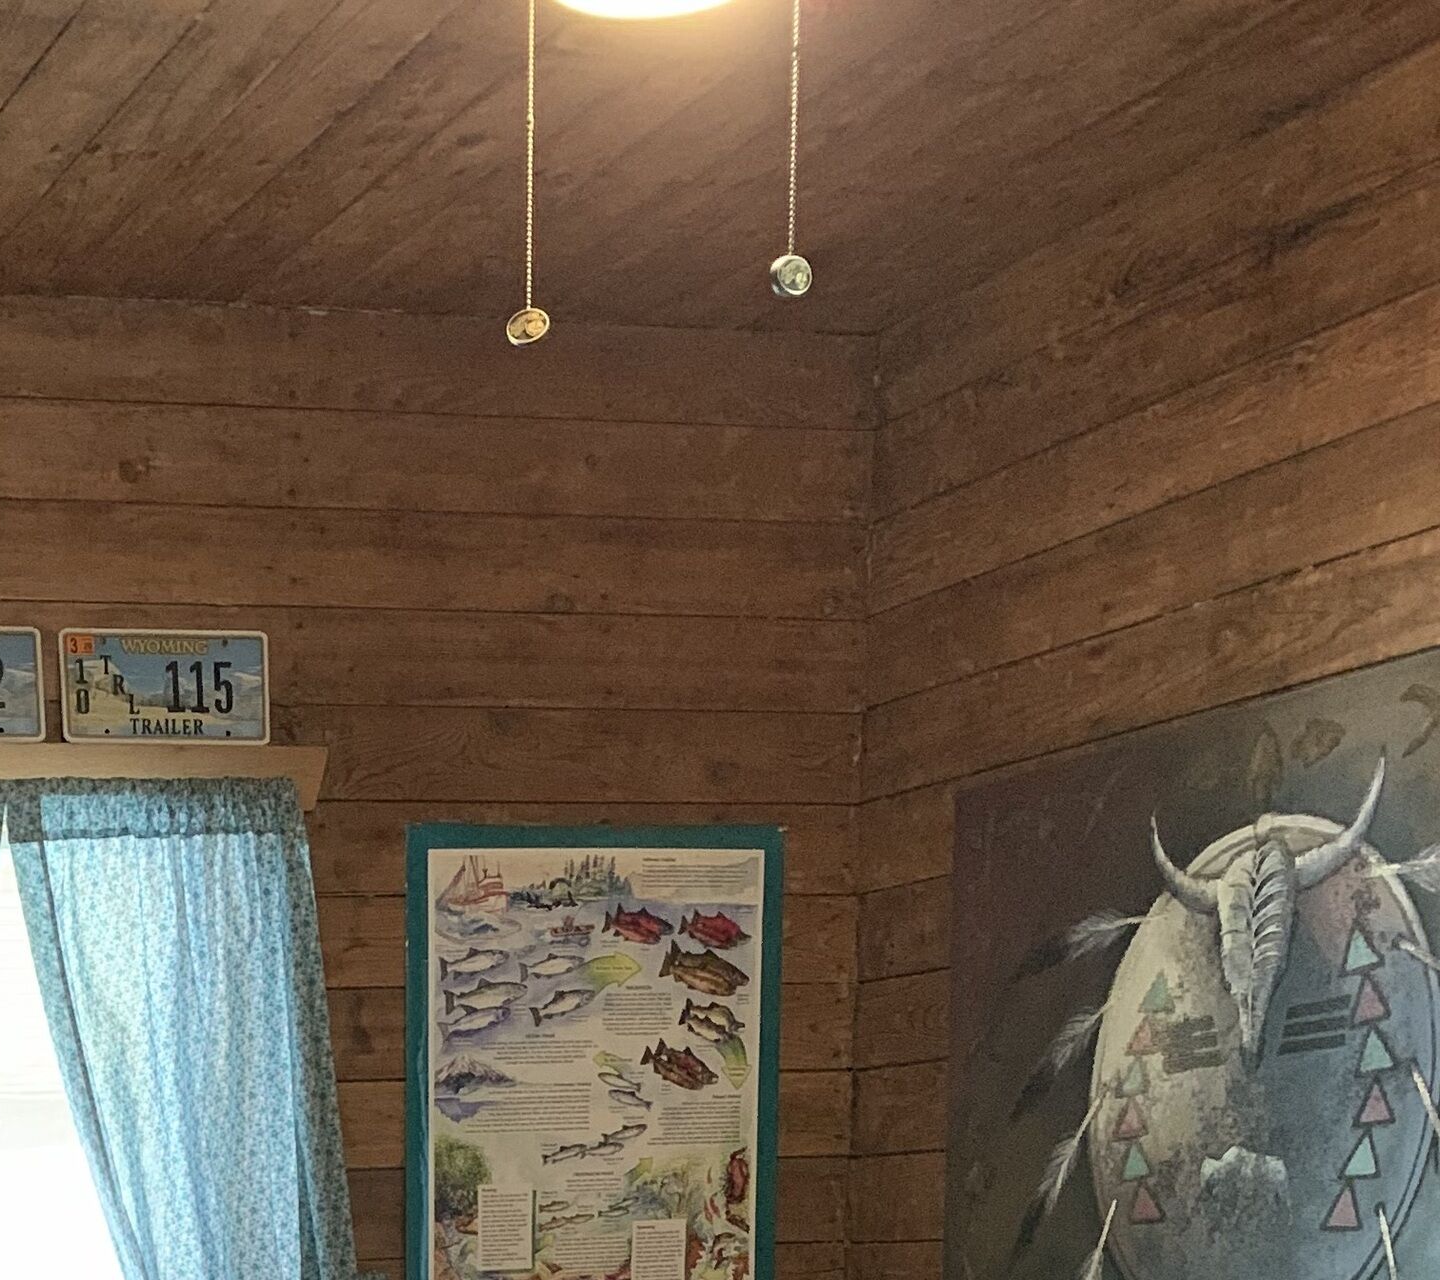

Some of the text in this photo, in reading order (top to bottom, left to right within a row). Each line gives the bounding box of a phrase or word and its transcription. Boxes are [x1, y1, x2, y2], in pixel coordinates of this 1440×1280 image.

[121, 640, 208, 655] WYOMING
[165, 660, 234, 714] 115
[130, 718, 204, 735] TRAILER
